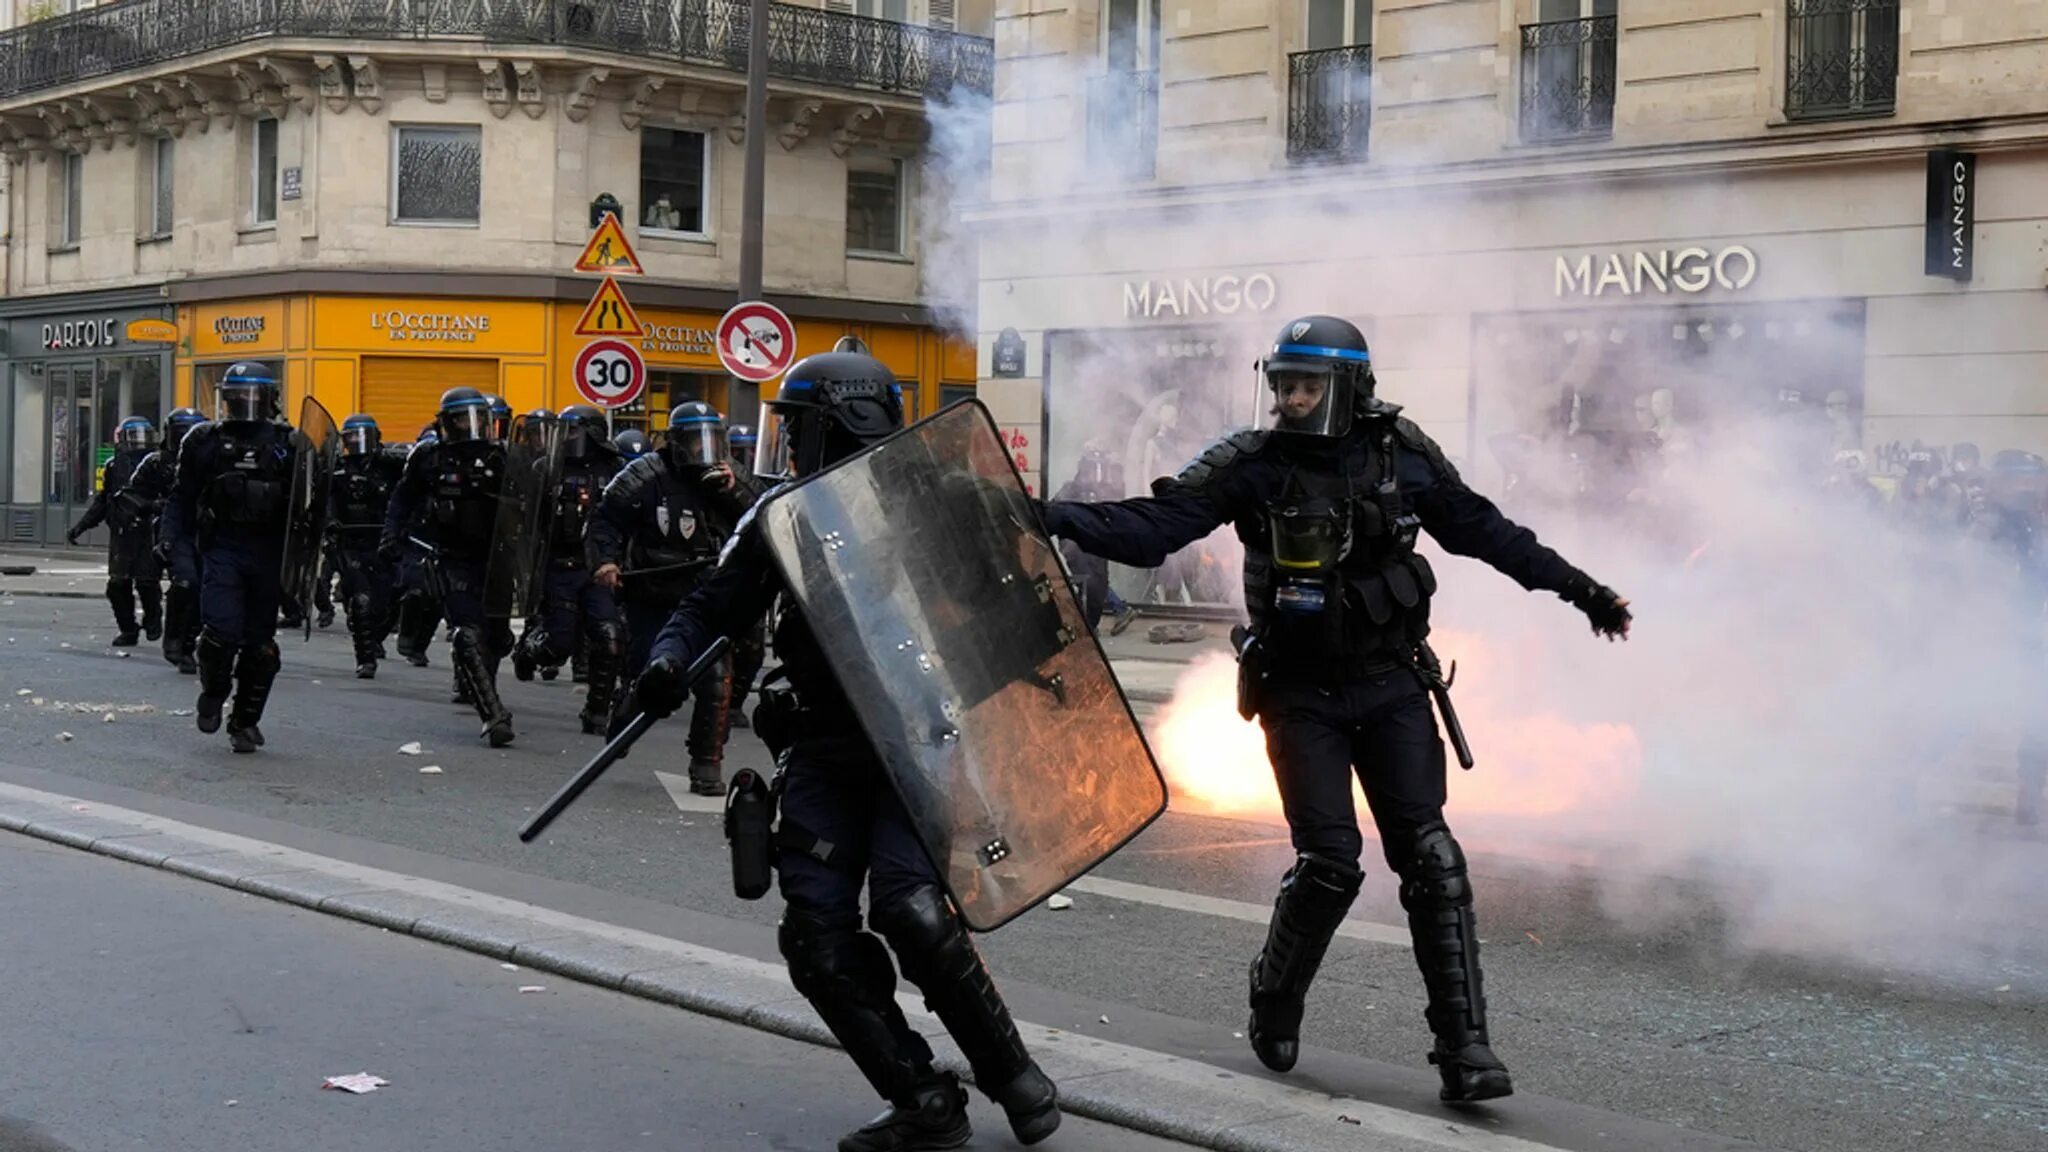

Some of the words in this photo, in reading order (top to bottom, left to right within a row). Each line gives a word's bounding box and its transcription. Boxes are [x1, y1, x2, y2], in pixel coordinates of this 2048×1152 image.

[1952, 161, 1966, 268] MANGO
[1555, 245, 1756, 296] MANGO
[1123, 272, 1276, 317] MANGO
[42, 318, 114, 348] PARFOIS
[371, 310, 489, 330] L'OCCITANE
[389, 330, 406, 340] EN
[410, 331, 476, 342] PROVENCE
[659, 342, 712, 354] PROVENCE
[589, 358, 632, 387] 30
